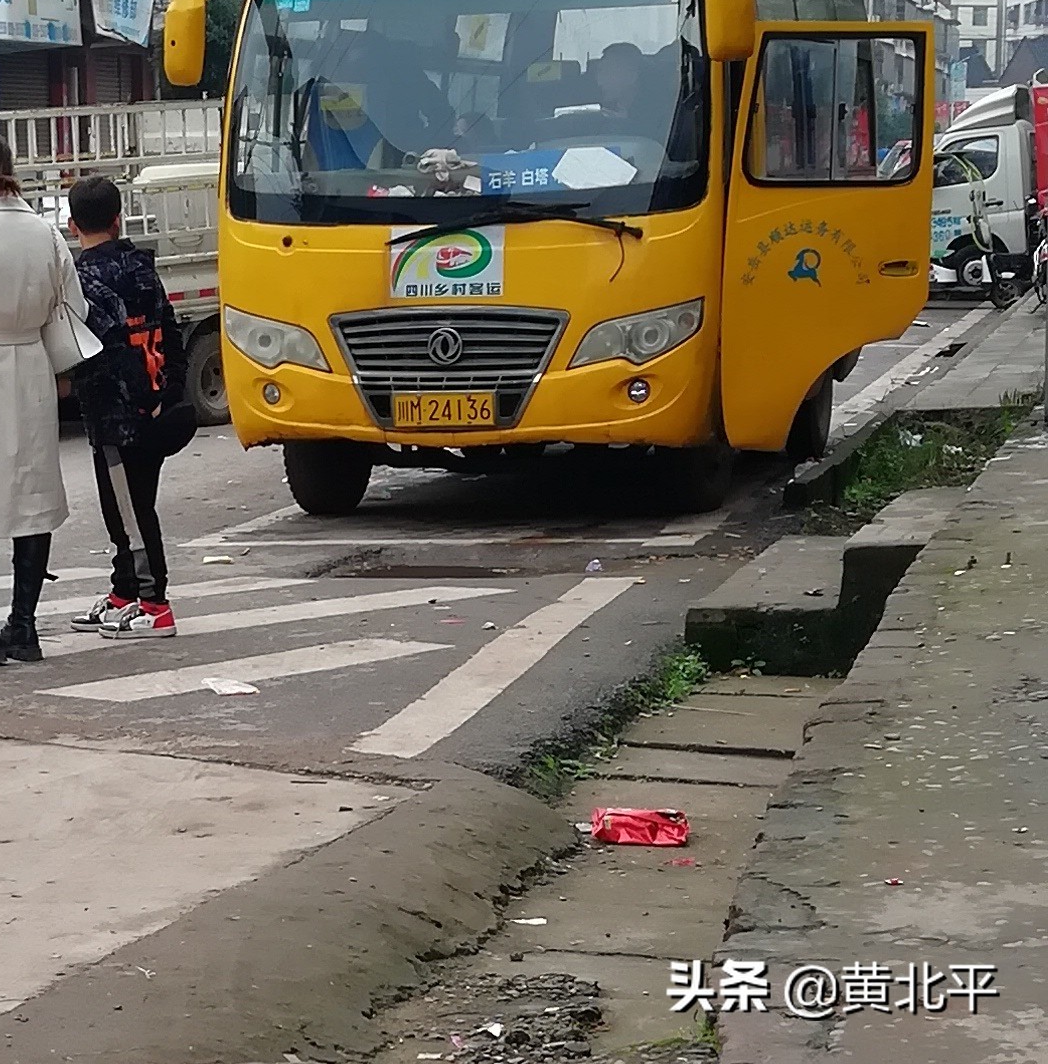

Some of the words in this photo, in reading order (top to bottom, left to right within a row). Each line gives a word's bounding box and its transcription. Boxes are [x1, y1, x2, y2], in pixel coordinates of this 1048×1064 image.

[488, 170, 517, 190] 石羊
[521, 167, 549, 186] 白塔
[405, 281, 502, 298] 四川乡村客运
